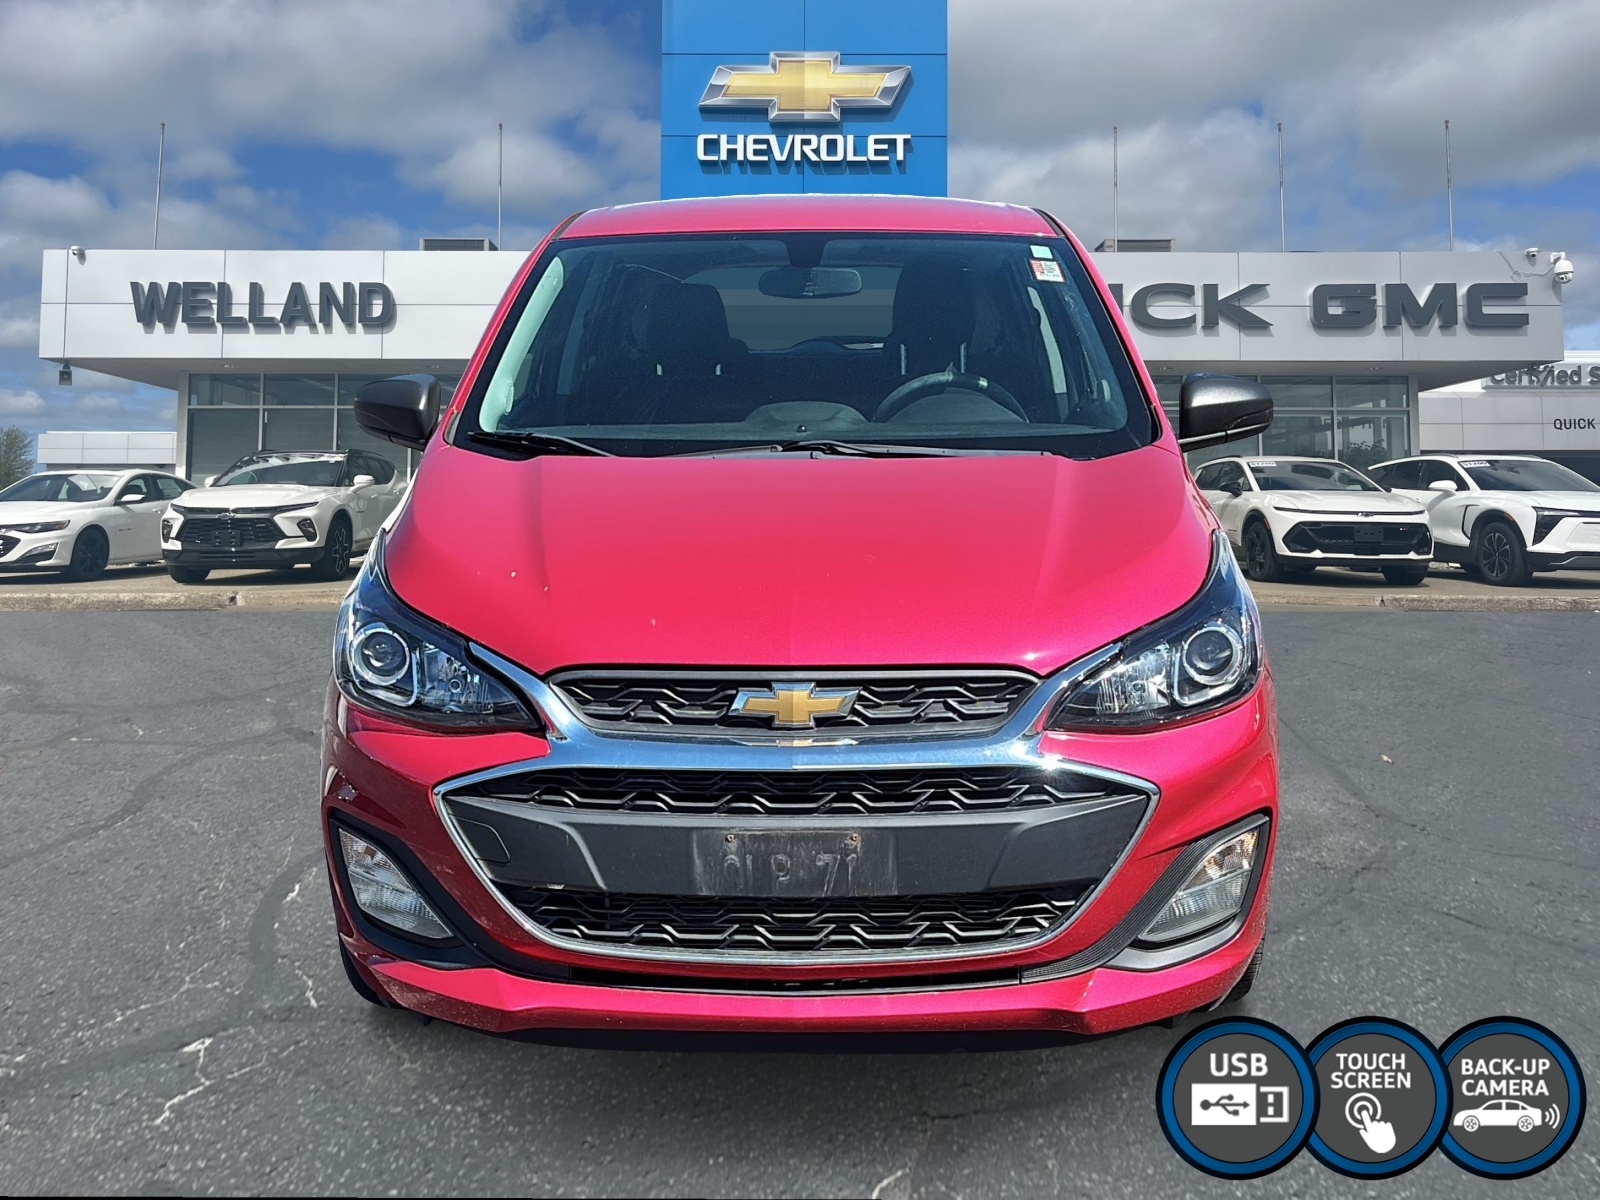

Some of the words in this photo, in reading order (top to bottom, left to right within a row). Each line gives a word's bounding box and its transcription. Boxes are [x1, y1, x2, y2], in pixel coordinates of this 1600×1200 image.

[697, 134, 911, 162] CHEVROLET
[130, 281, 393, 326] WELLAND
[1310, 283, 1530, 328] GMC
[1553, 418, 1596, 430] QUICK
